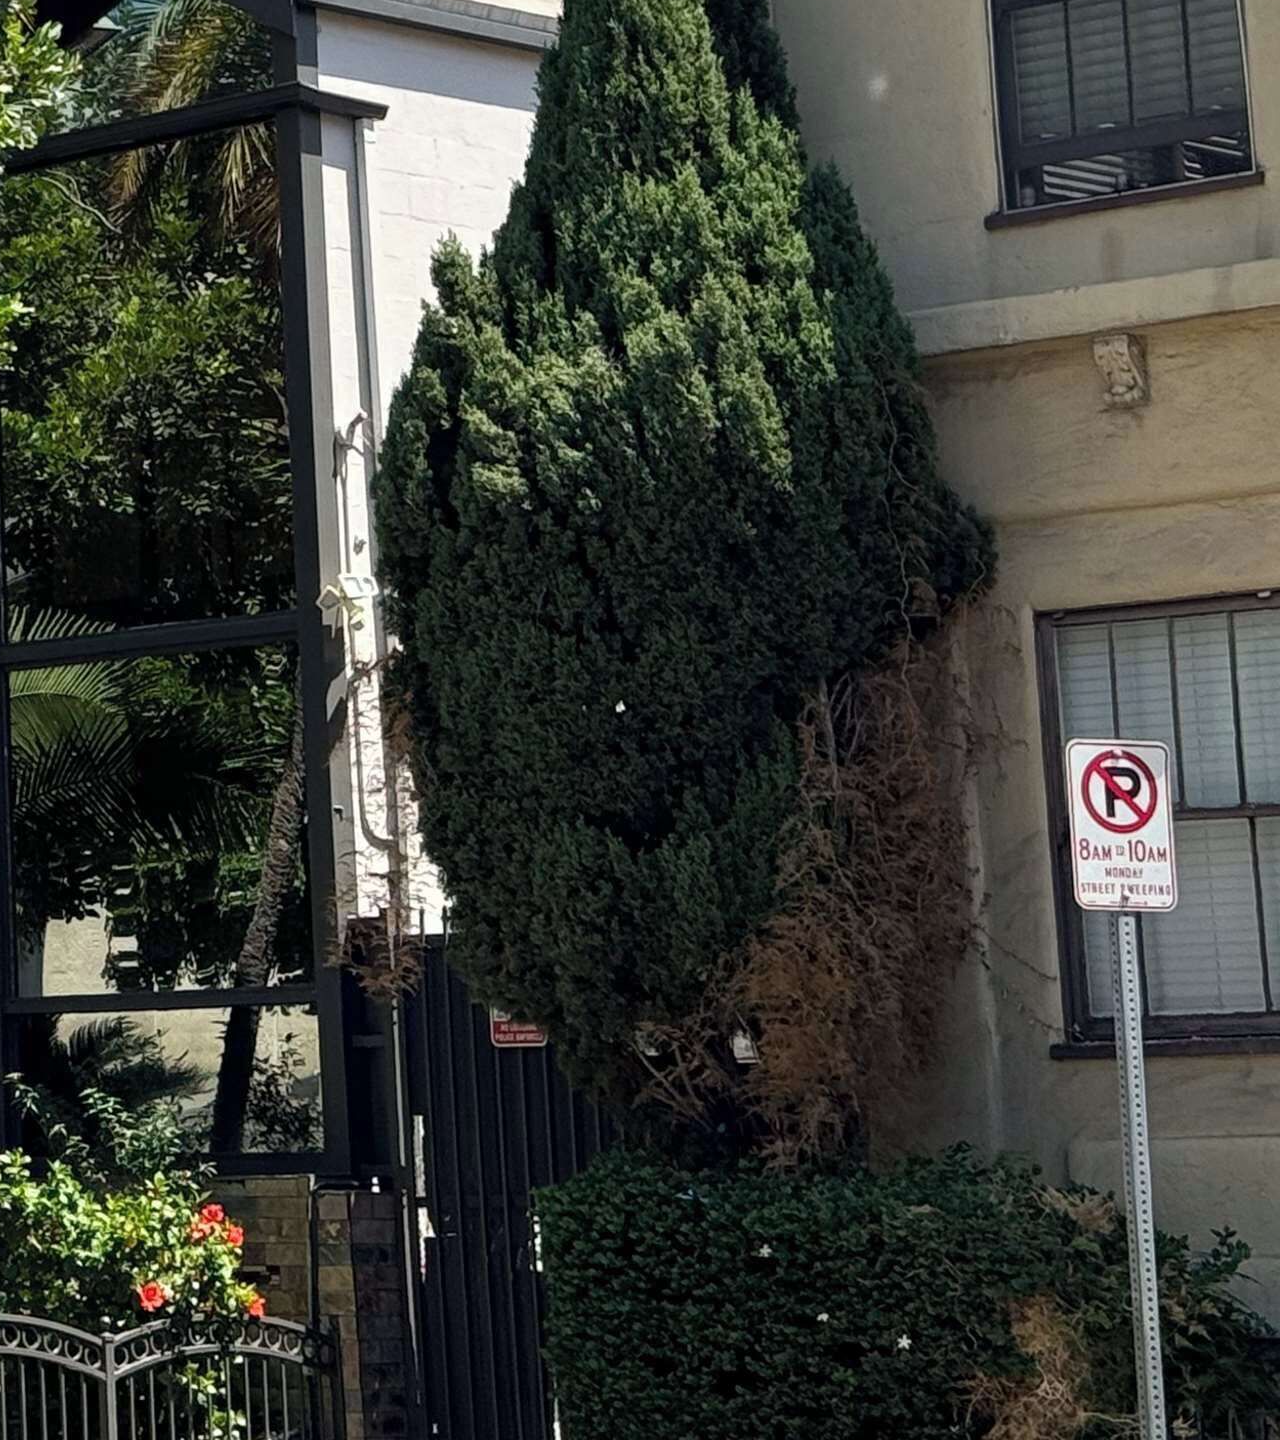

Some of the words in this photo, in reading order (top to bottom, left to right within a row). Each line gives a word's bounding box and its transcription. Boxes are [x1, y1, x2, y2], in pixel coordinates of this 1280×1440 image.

[1079, 838, 1112, 861] 8AM
[1127, 840, 1168, 863] 10AM
[1105, 867, 1144, 879] MONDAY
[1081, 882, 1116, 894] STREET
